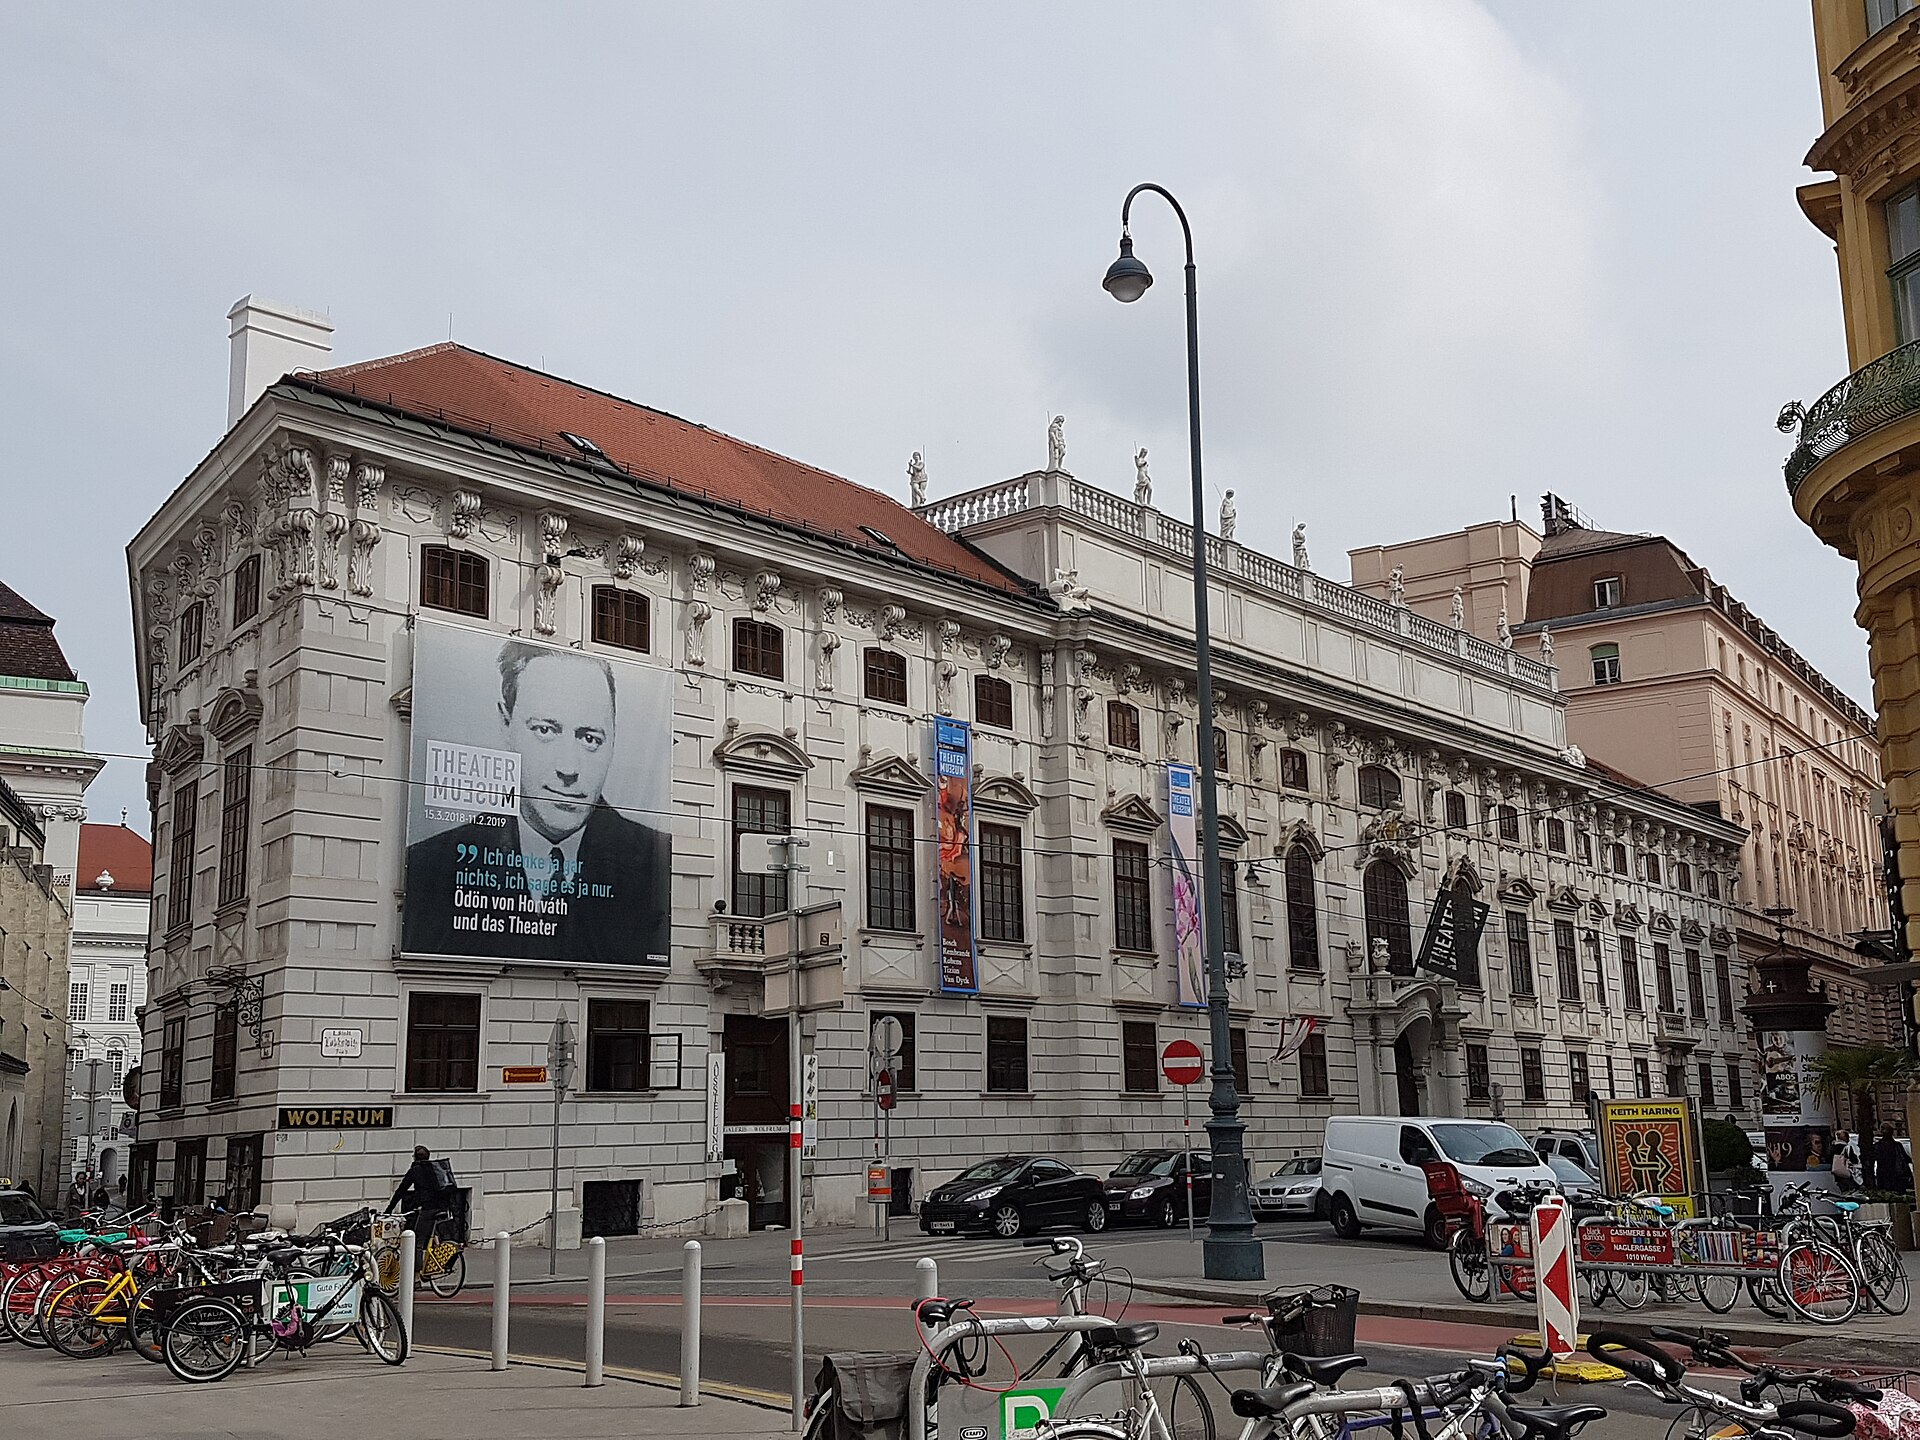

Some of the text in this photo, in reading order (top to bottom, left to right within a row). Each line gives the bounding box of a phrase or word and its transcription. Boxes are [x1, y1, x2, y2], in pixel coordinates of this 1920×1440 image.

[432, 748, 515, 782] THEATER
[939, 751, 964, 766] THEATER
[483, 847, 503, 866] Ich
[506, 850, 545, 870] denke
[548, 854, 560, 874] ja
[562, 859, 584, 876] gar
[455, 867, 615, 899] nichts, ich sage es ja nur.
[454, 886, 568, 916] Ödön von Horváth
[453, 913, 558, 937] und das Theater
[711, 1061, 719, 1153] AUSSTELLUNG
[1610, 1107, 1680, 1116] KEITH HARING
[287, 1109, 385, 1126] WOLFRUM
[1610, 1228, 1667, 1239] CASHMERE & SILK
[1613, 1244, 1662, 1253] NAGLERGASSE
[1625, 1253, 1656, 1262] 1010 Wien
[316, 1283, 333, 1293] Gute
